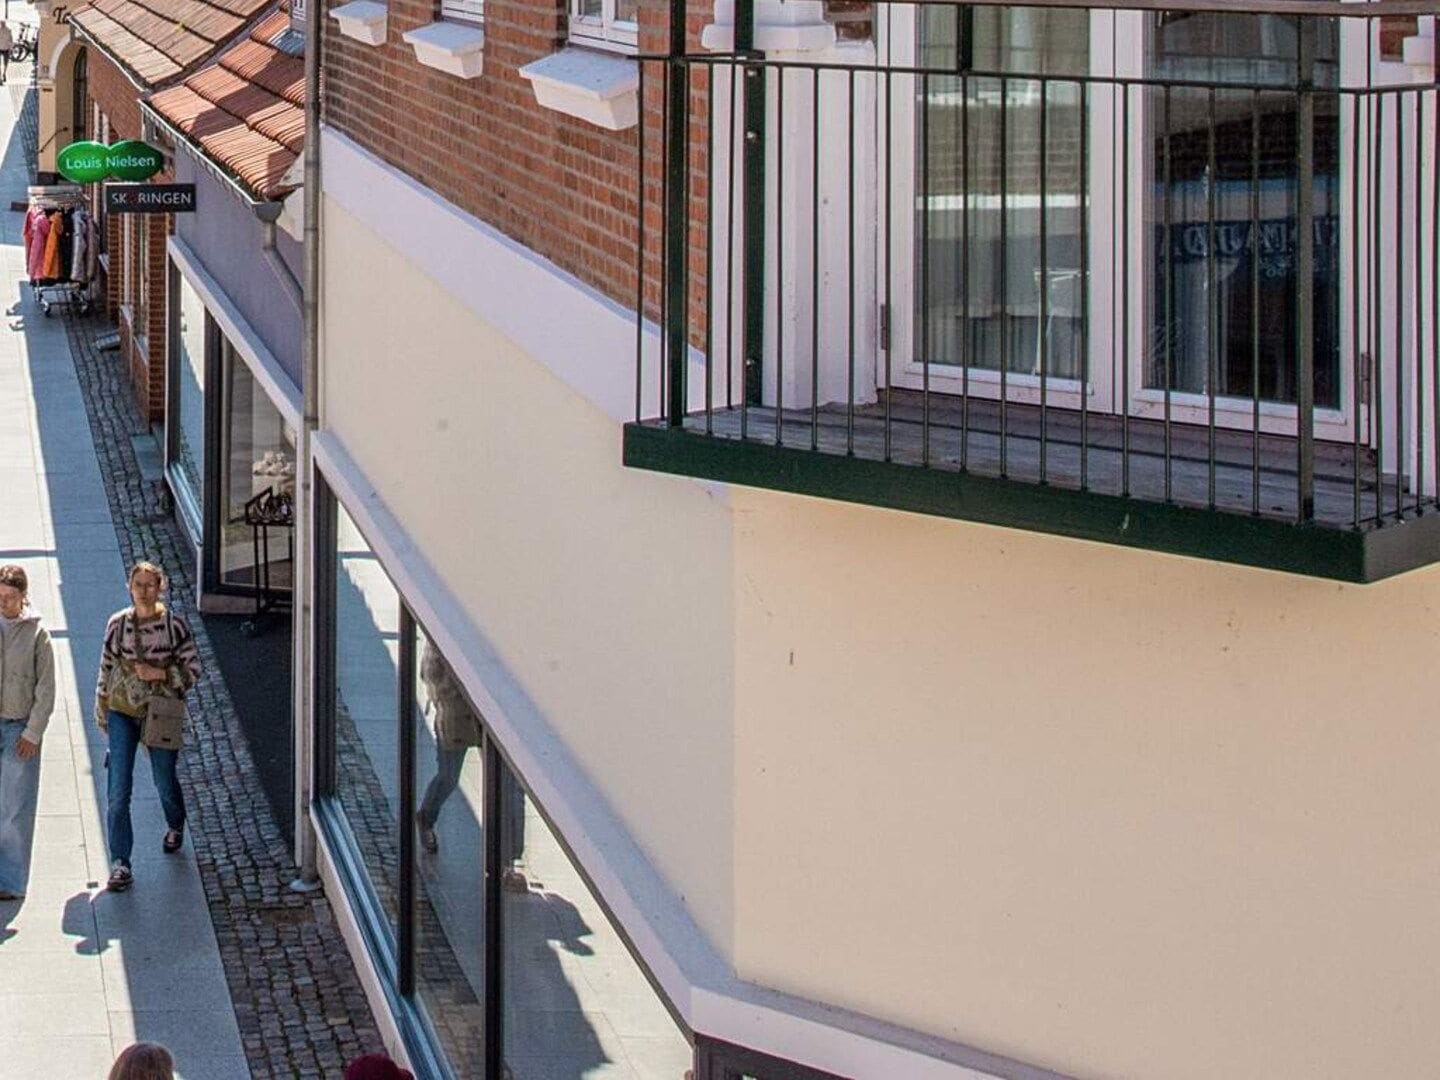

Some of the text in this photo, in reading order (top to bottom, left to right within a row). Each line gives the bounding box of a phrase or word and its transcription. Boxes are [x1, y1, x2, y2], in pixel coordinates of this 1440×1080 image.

[66, 156, 156, 170] Louis Nielsen
[111, 192, 191, 204] SKRINGEN
